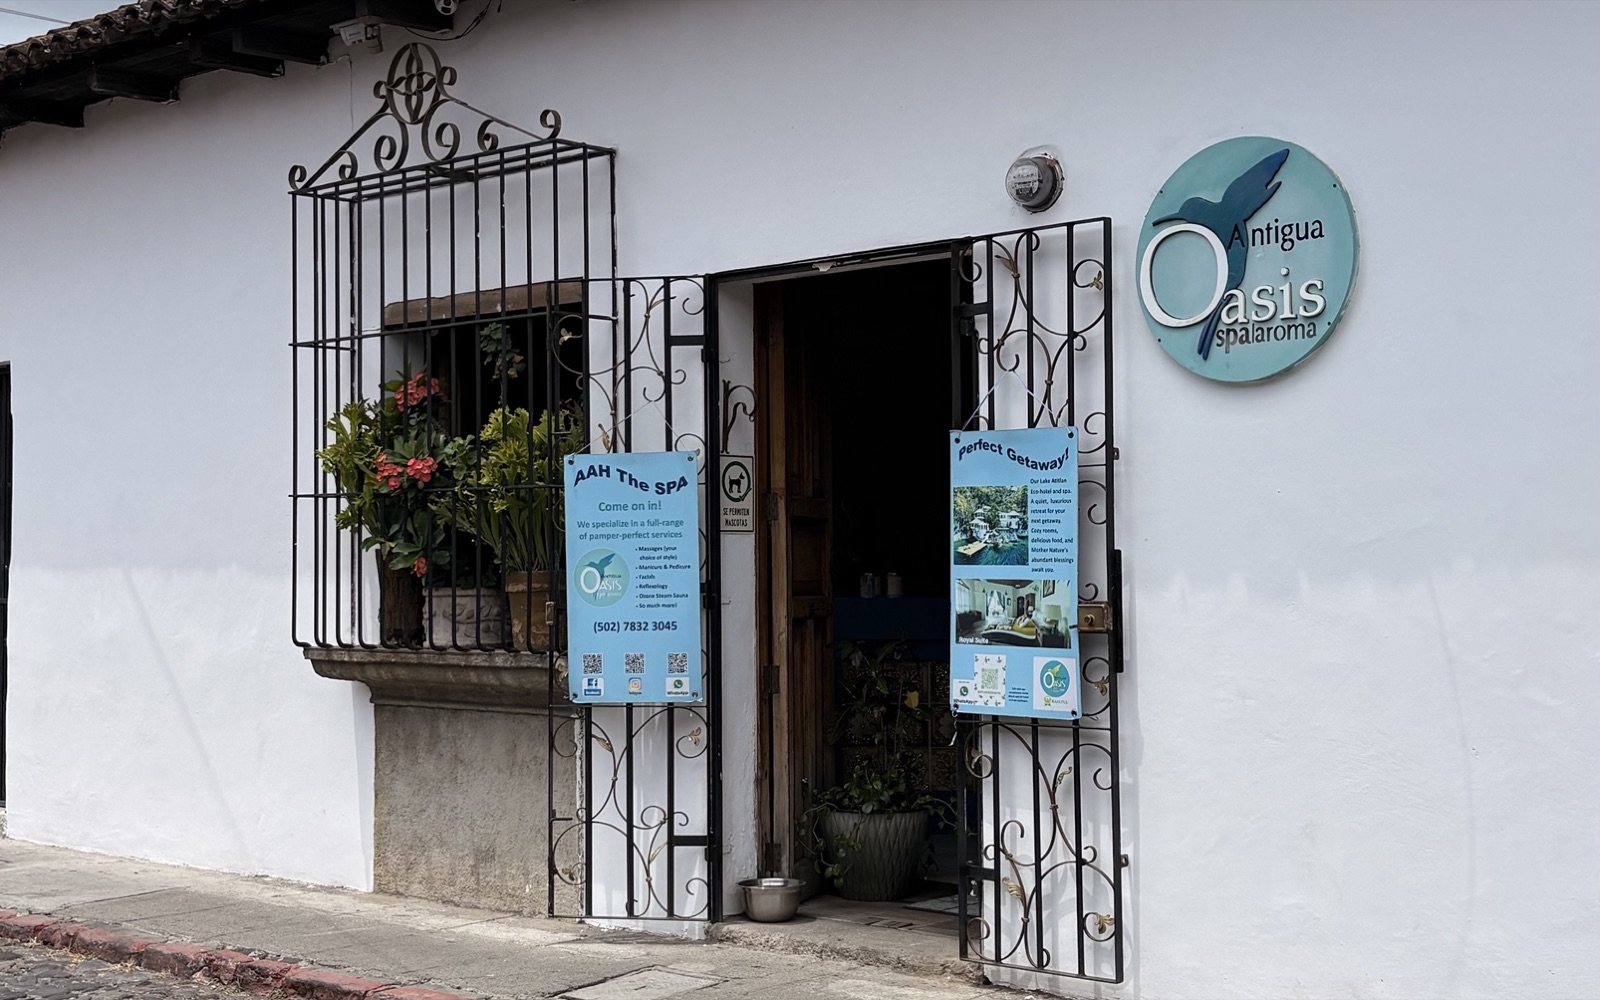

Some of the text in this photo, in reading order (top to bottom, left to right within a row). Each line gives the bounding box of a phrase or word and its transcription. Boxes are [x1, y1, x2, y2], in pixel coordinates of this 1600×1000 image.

[1228, 218, 1325, 251] Antigua
[1140, 222, 1327, 329] Oasis
[959, 438, 1069, 471] Perfect Getaway!
[573, 464, 689, 495] AAH The SPA
[598, 500, 662, 511] Come on in!
[729, 507, 750, 516] PERMITEN
[577, 520, 590, 528] We
[592, 519, 629, 530] specialize
[631, 519, 639, 527] in
[647, 518, 684, 529] full-range
[725, 519, 748, 527] MASCOTAS
[579, 529, 683, 541] of pamper-perfect services
[1052, 537, 1064, 545] food,
[1054, 557, 1074, 565] blessings
[639, 583, 668, 591] Reflexology
[593, 620, 678, 633] (502) 7832 3045
[958, 636, 989, 644] Royal Suite
